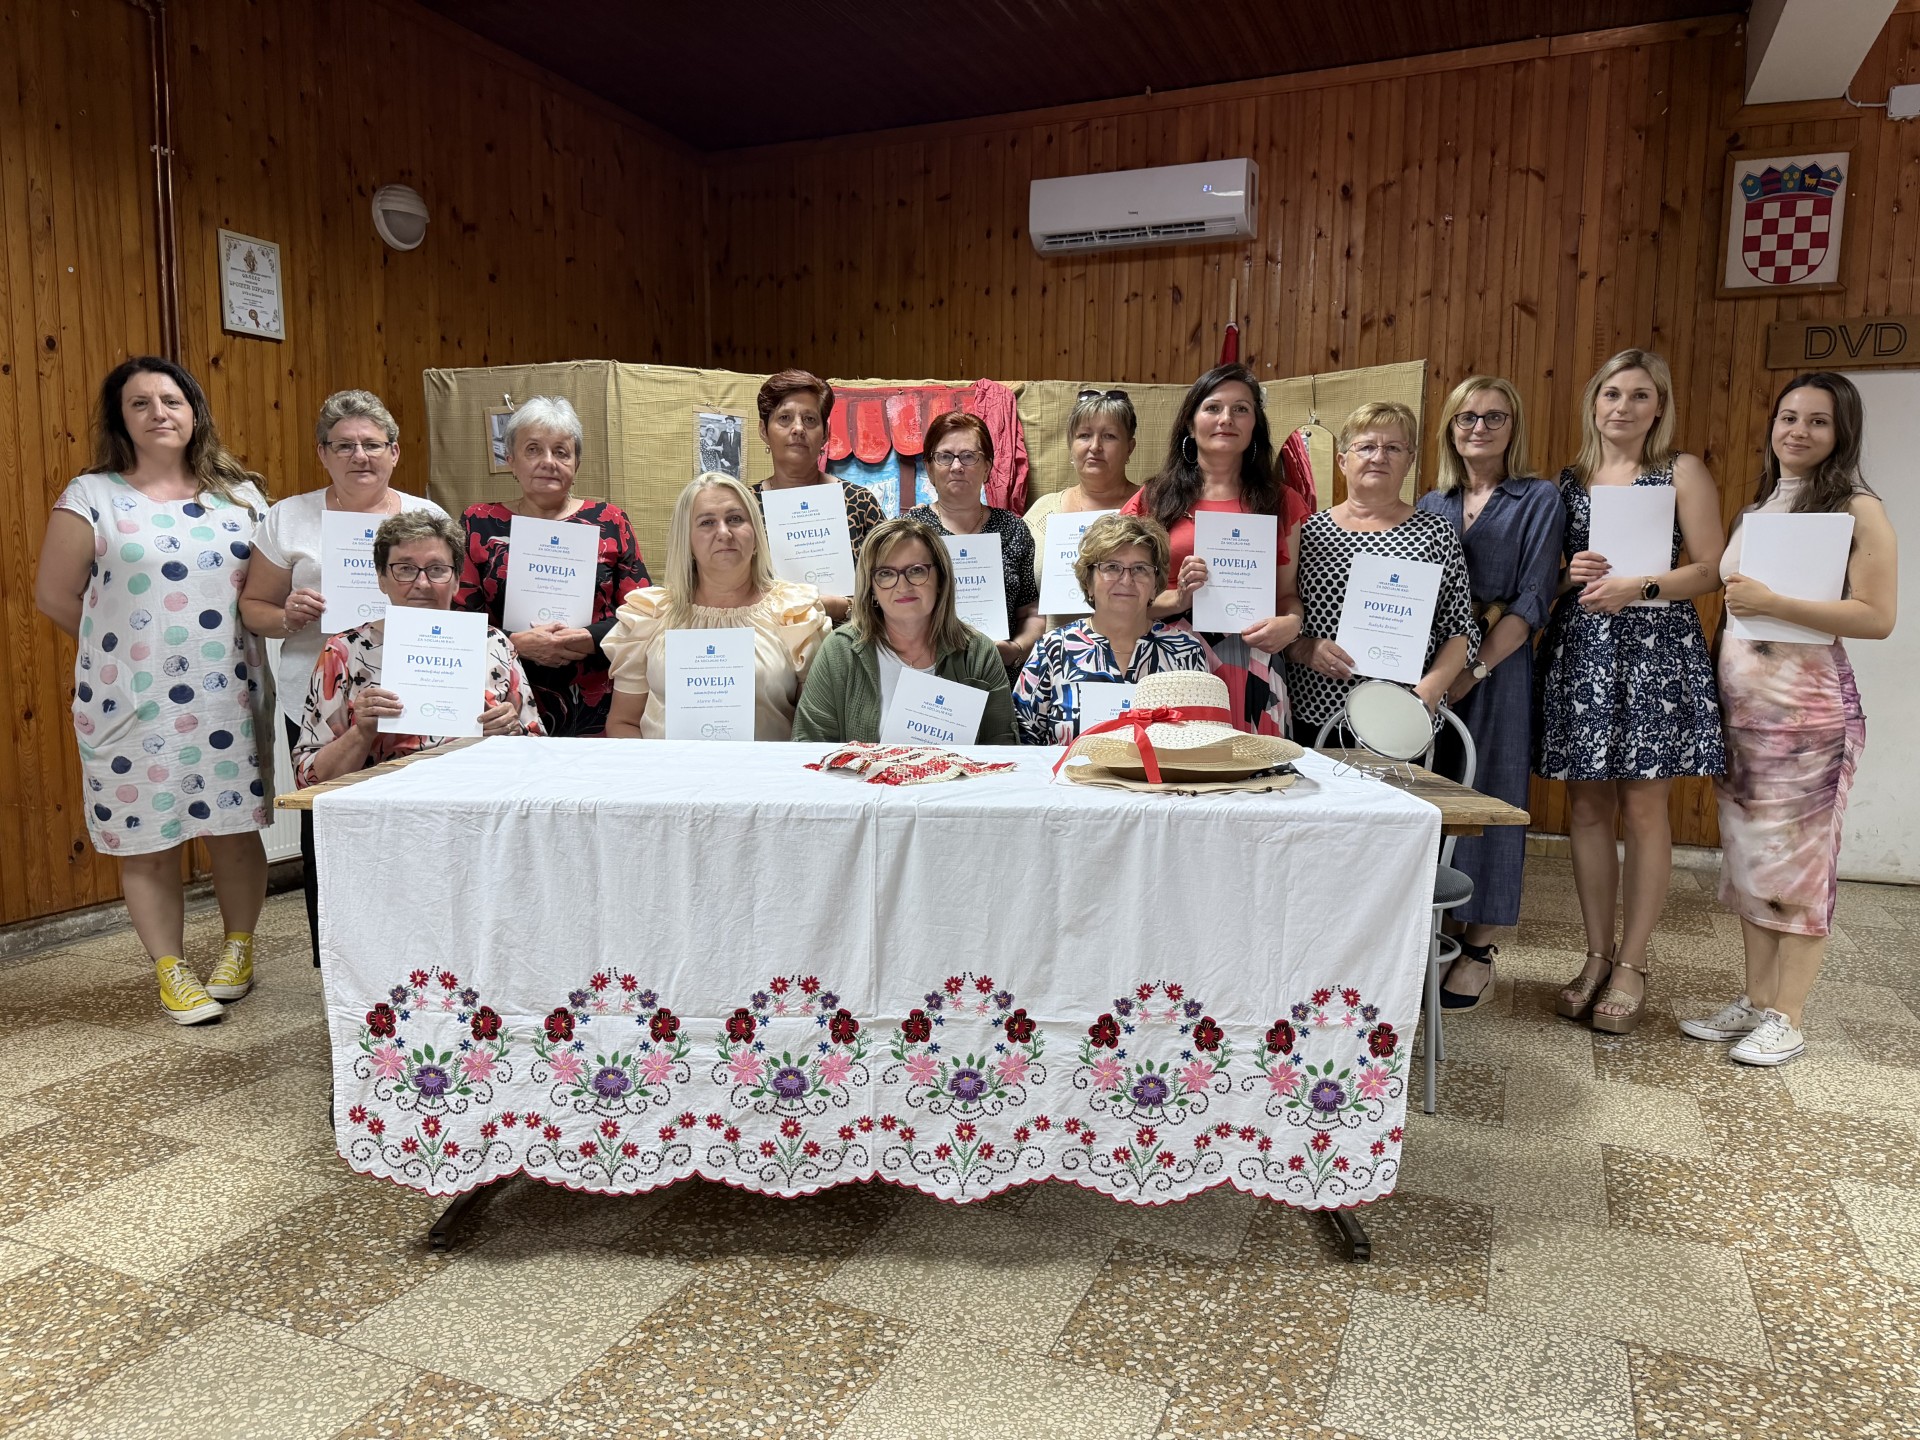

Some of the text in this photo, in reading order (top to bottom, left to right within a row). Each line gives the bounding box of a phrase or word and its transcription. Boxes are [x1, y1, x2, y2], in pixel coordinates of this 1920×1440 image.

[1804, 323, 1907, 359] DVD
[786, 528, 830, 540] POVELJA
[344, 558, 375, 568] POVE
[1213, 558, 1257, 570] POVELJA
[528, 563, 576, 577] POVELJA
[954, 576, 986, 585] VELJA
[1364, 600, 1412, 616] POVELJA
[407, 654, 462, 668] POVELJA
[687, 677, 735, 687] POVELJA
[906, 720, 954, 742] POVELJA
